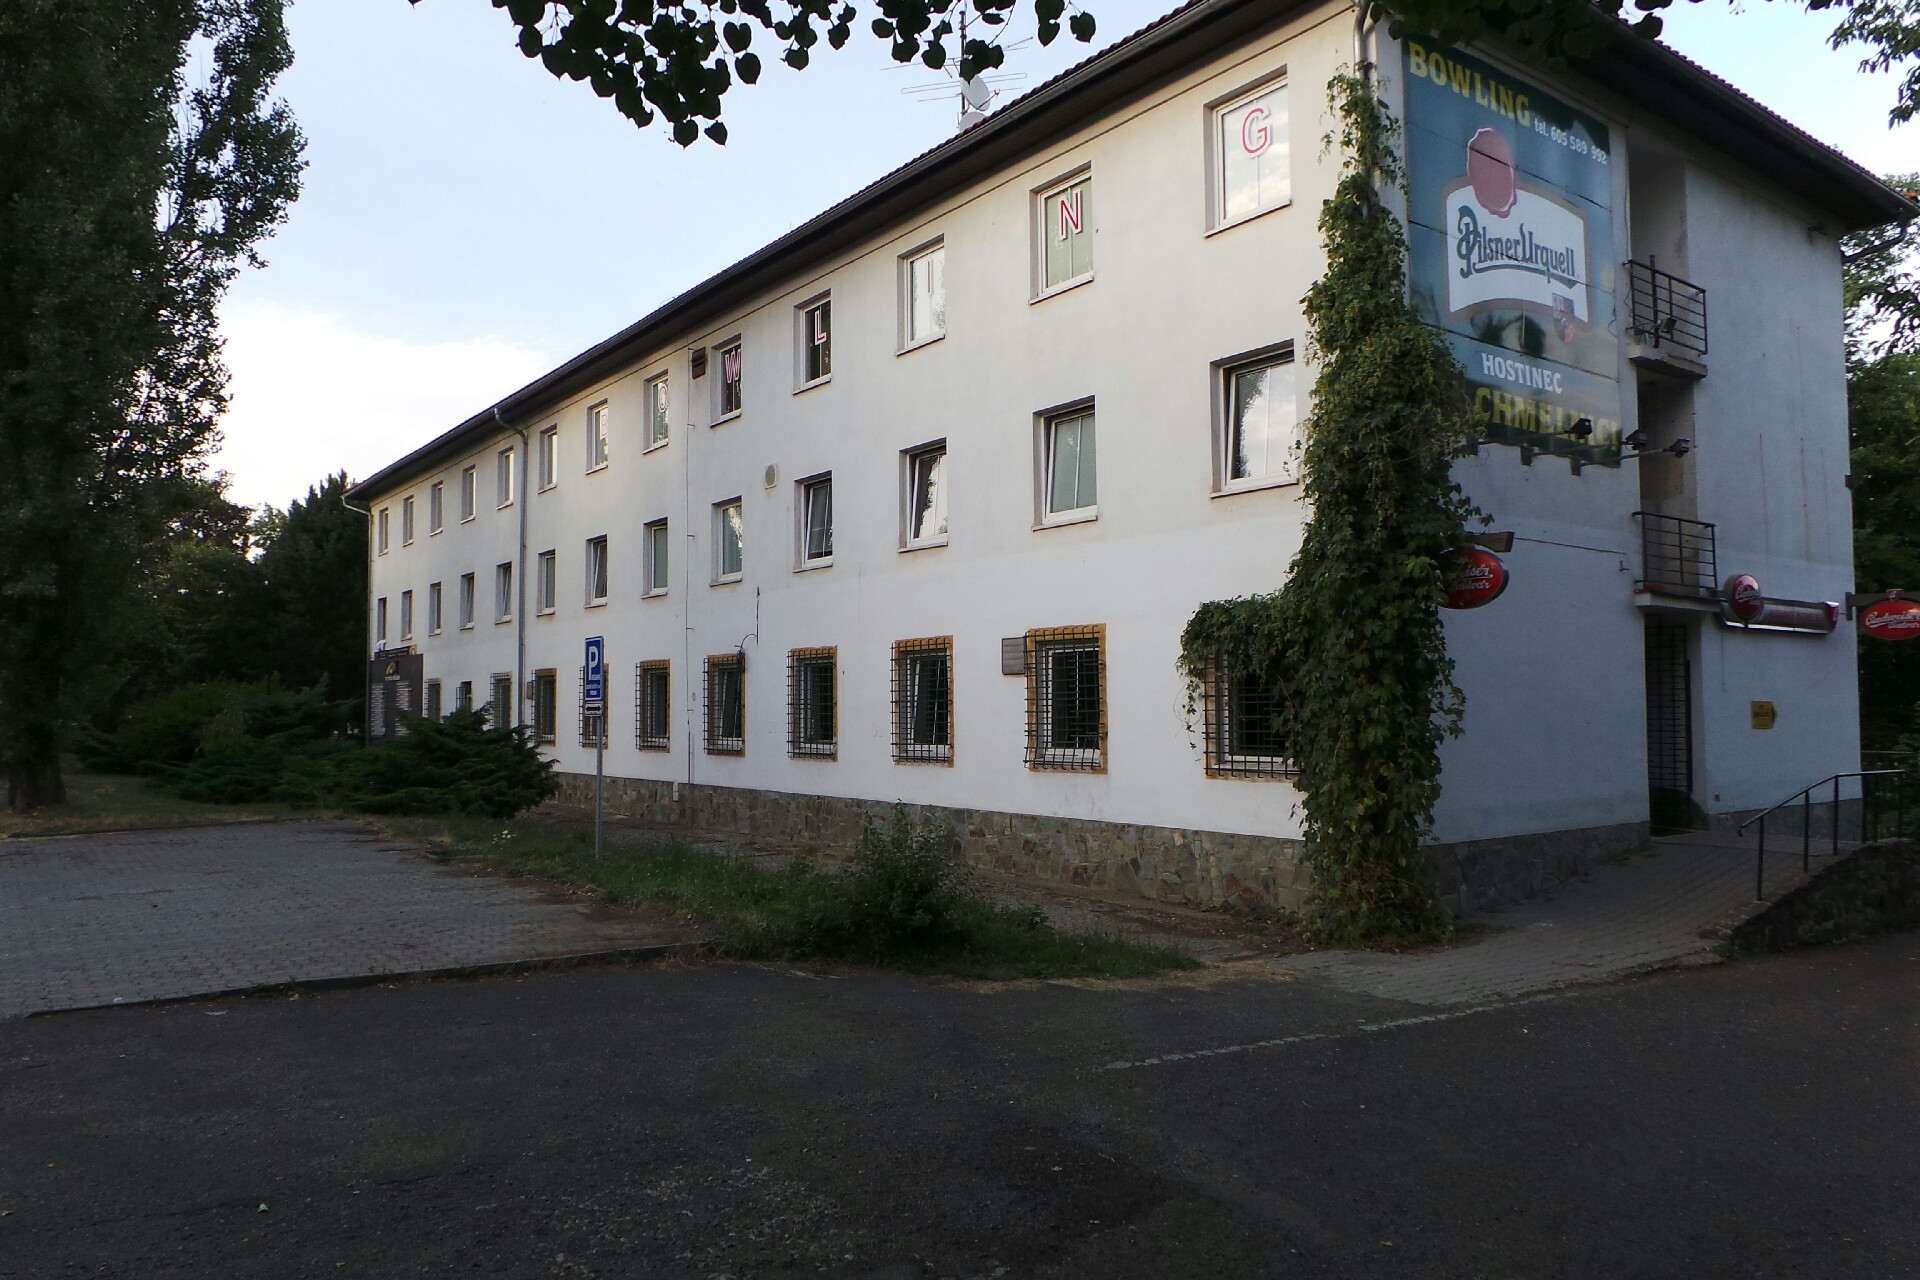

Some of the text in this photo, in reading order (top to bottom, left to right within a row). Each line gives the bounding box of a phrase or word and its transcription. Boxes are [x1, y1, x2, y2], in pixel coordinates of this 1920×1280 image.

[1408, 41, 1531, 128] BOWLING
[1534, 117, 1549, 137] tel.
[1551, 126, 1568, 146] 605
[815, 310, 827, 345] L
[1060, 191, 1080, 238] N
[1242, 106, 1268, 154] G
[1456, 205, 1576, 285] Pilsner Urquell
[1481, 352, 1562, 394] HOSTINEC
[588, 645, 599, 680] P
